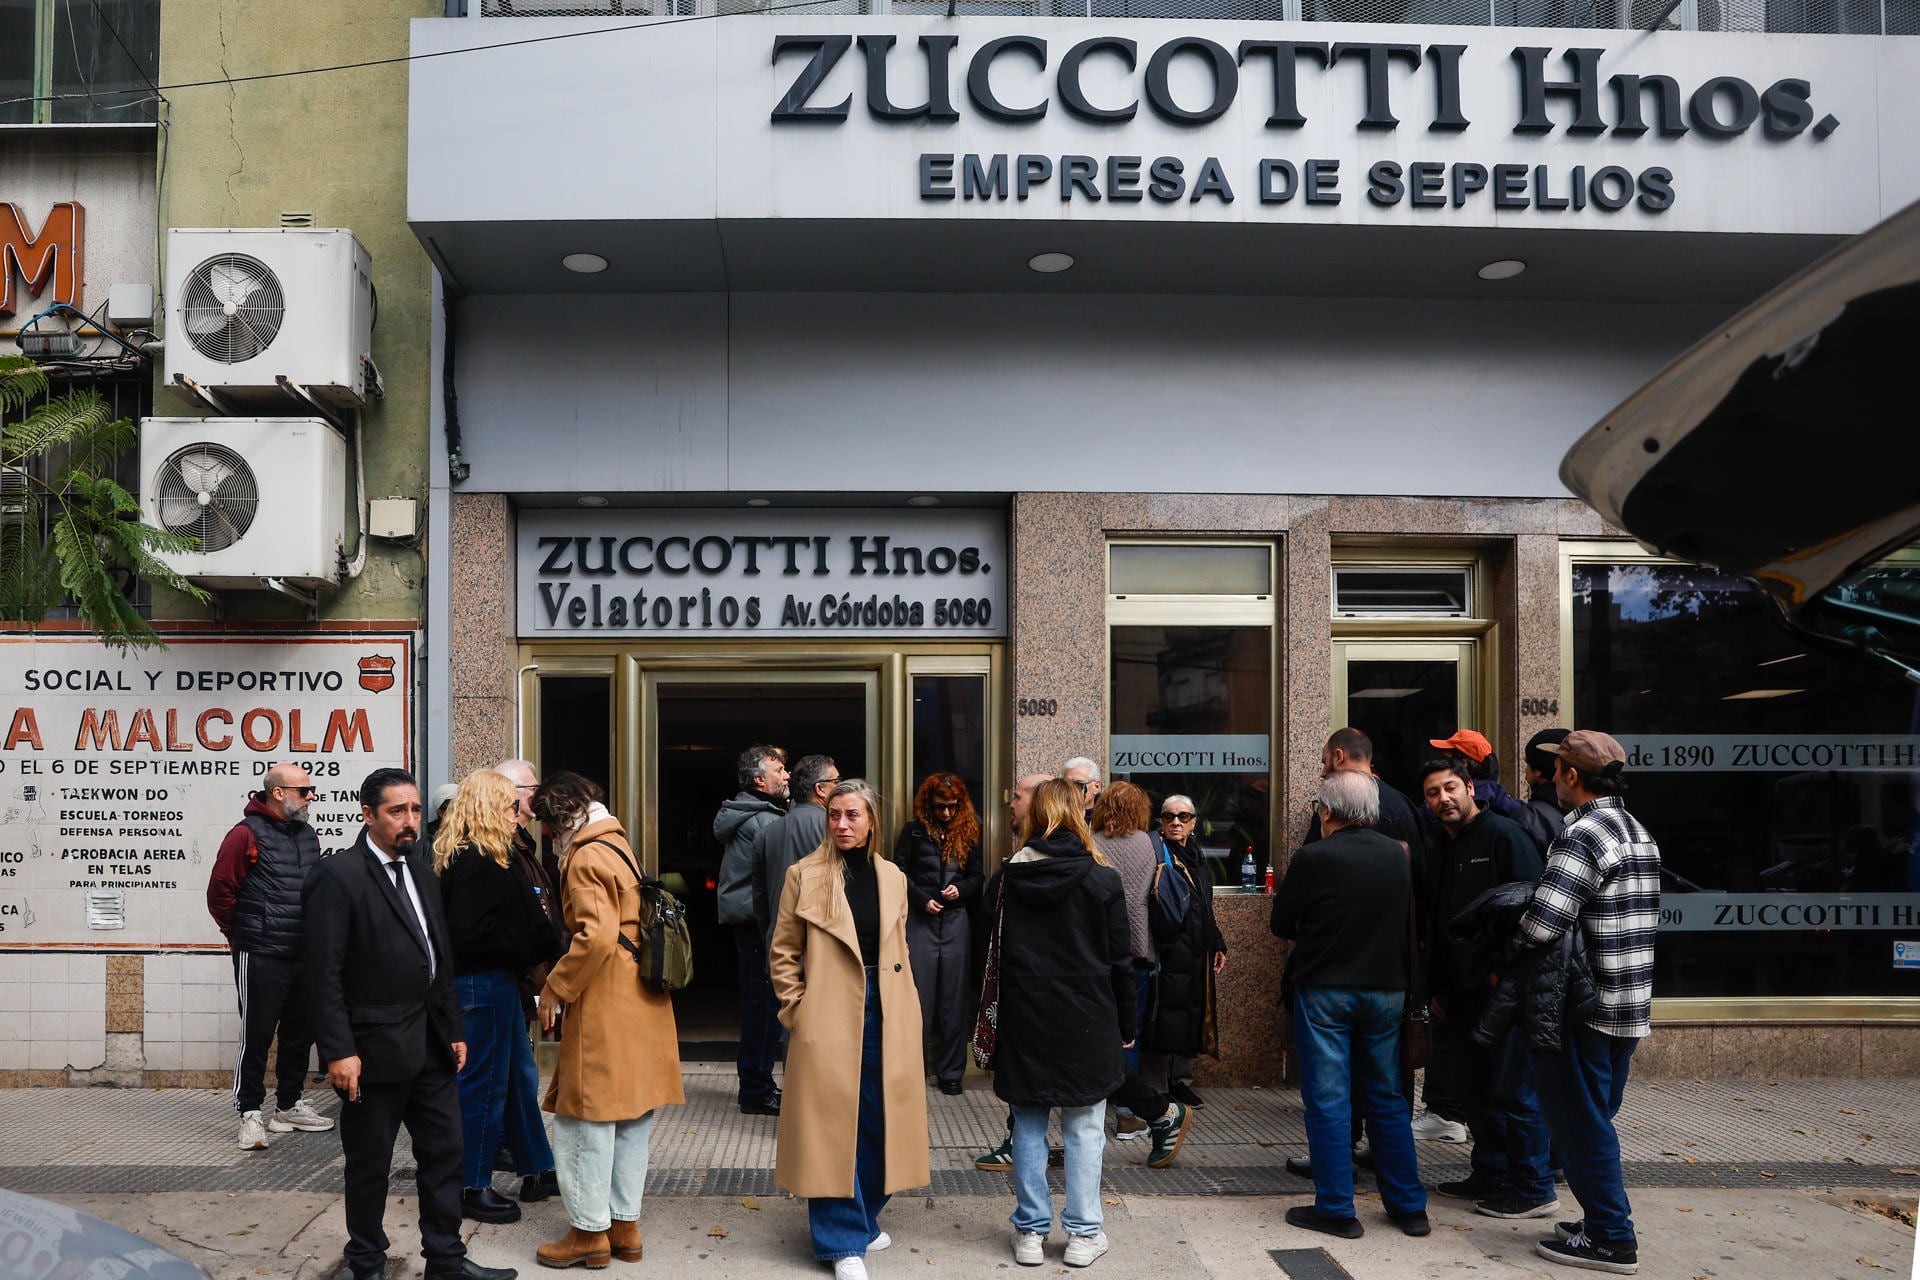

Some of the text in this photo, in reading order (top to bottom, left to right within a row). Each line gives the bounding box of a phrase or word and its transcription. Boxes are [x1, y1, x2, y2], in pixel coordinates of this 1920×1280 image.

[770, 35, 1840, 141] ZUCCOTTI Hnos.
[919, 153, 1675, 213] EMPRESA DE SEPELIOS
[538, 536, 992, 576] ZUCCOTTI Hnos.
[538, 583, 762, 628] Velatorios
[935, 597, 992, 627] 5080
[24, 669, 343, 692] SOCIAL Y DEPORTIVO
[1018, 698, 1058, 717] 5080
[1521, 698, 1559, 716] 5084
[74, 707, 374, 753] MALCOLM
[1114, 751, 1268, 768] ZUCCOTTI Hnos.
[1662, 744, 1715, 768] 1890
[1731, 743, 1887, 767] ZUCCOTTI
[21, 759, 43, 775] EL
[51, 759, 65, 774] 6
[74, 759, 99, 775] DE
[109, 759, 240, 776] SEPTIEMBRE
[60, 827, 183, 837] DEFENSA PERSONAL
[60, 848, 186, 861] ACROBACIA AEREA
[87, 864, 152, 875] EN TELAS
[69, 880, 177, 889] PARA PRINCIPIANTES
[1713, 904, 1881, 927] ZUCCOTTI
